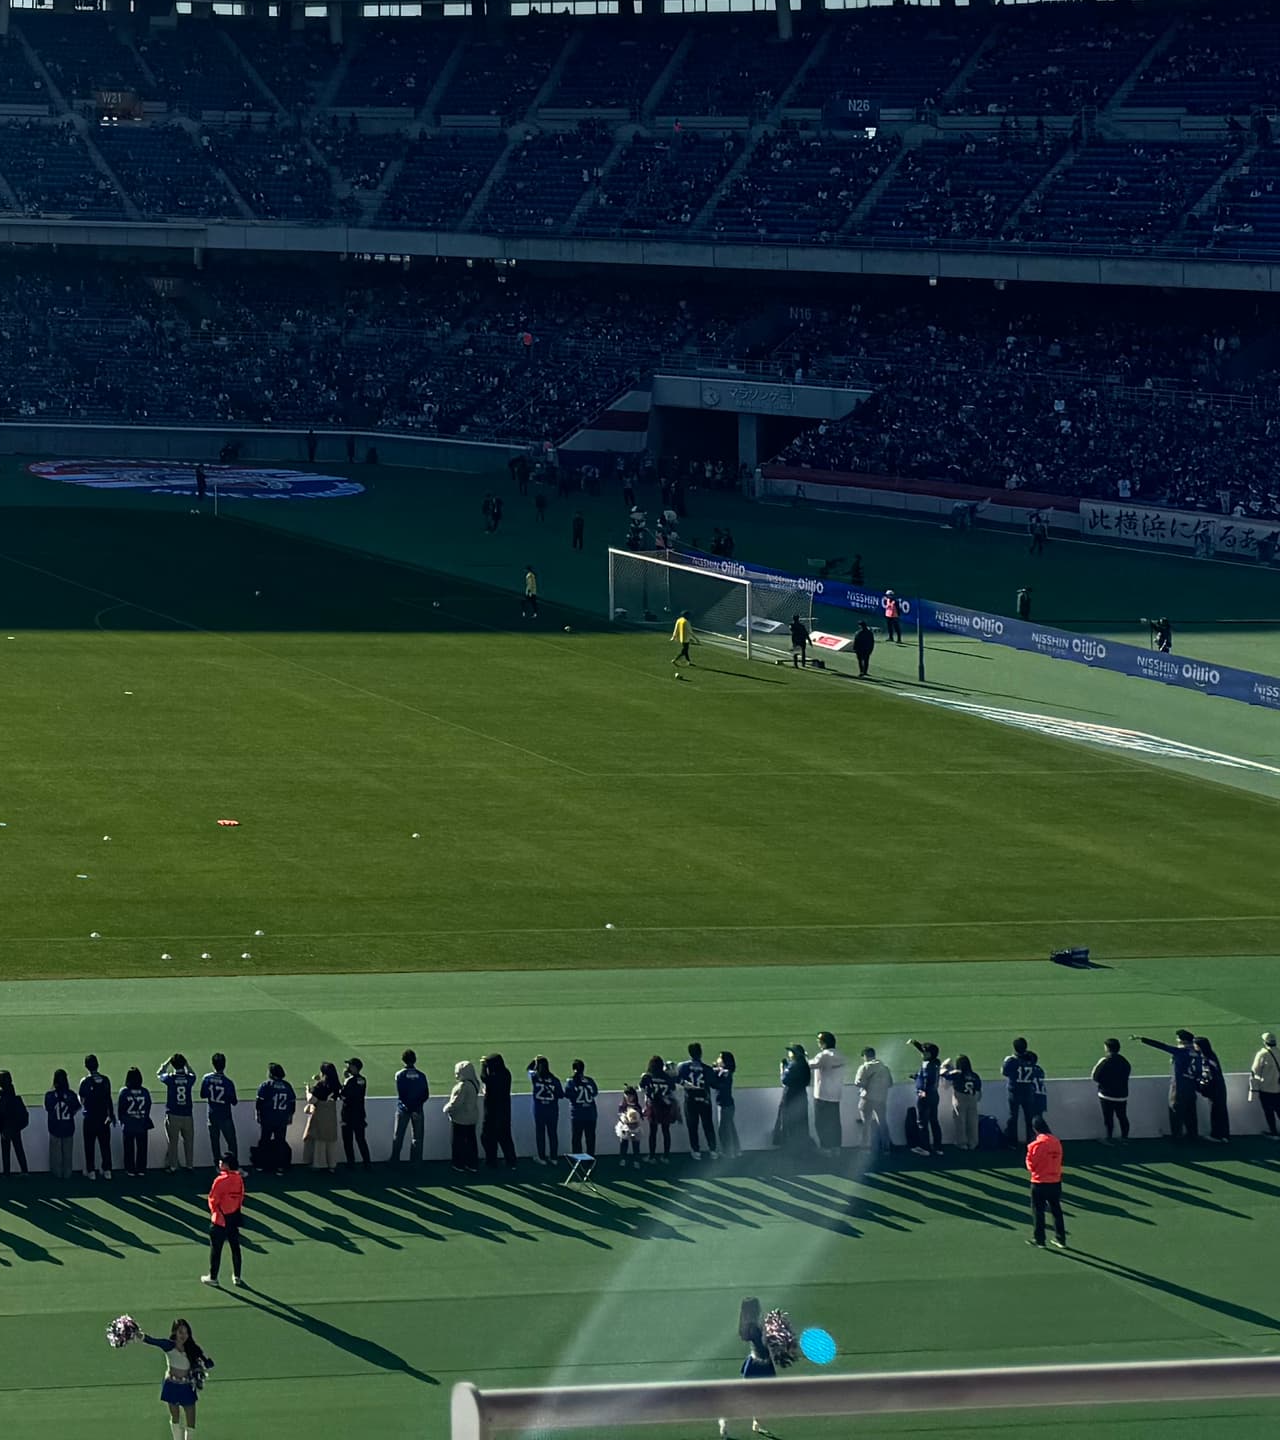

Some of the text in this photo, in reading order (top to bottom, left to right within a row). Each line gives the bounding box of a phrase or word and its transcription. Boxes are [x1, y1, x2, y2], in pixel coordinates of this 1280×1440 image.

[102, 92, 122, 103] W21
[848, 99, 870, 112] N26
[153, 279, 174, 290] W11
[790, 306, 811, 320] N16
[847, 591, 880, 606] NISSHIN
[935, 611, 970, 626] NISSHIN
[1032, 631, 1070, 649] NISSHIN
[1137, 655, 1179, 674] NISSHIN
[176, 1086, 187, 1102] 8
[55, 1101, 71, 1120] 12
